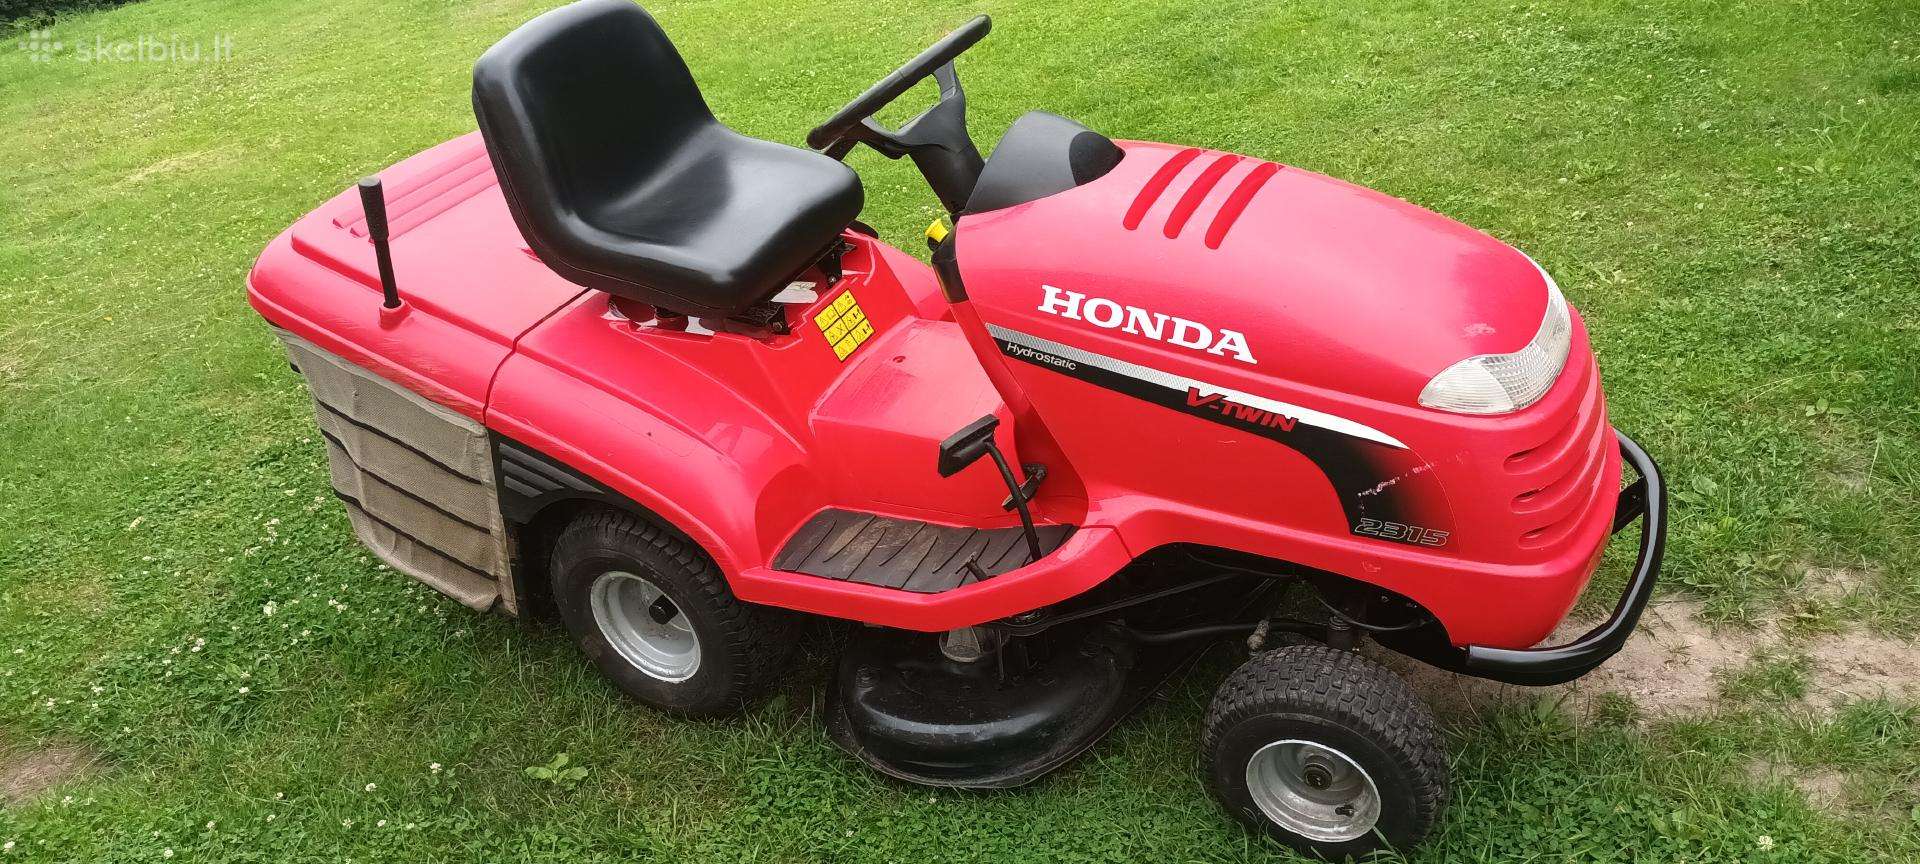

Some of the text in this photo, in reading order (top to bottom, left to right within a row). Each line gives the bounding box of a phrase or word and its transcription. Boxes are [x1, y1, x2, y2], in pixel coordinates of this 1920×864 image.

[1038, 284, 1258, 364] HONDA
[1006, 341, 1077, 372] Hydrostatic
[1186, 387, 1299, 433] V-TWIN
[1354, 518, 1450, 548] 2315
